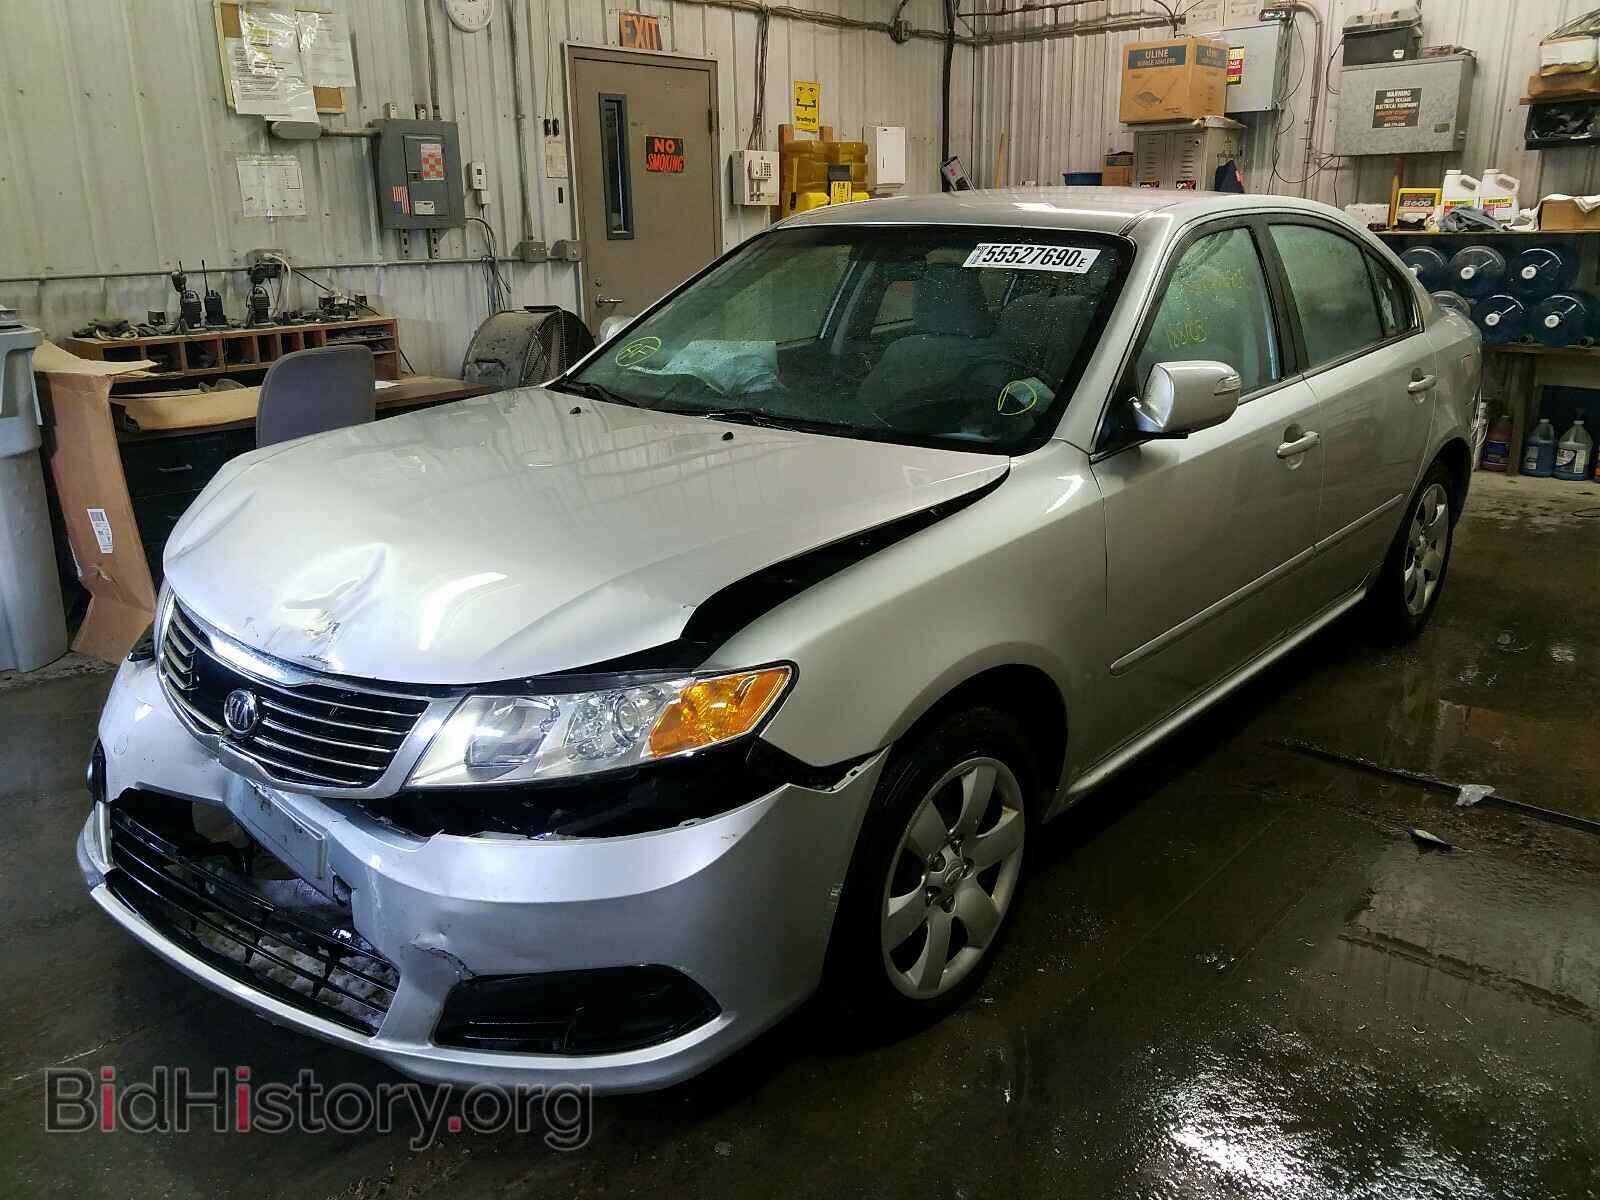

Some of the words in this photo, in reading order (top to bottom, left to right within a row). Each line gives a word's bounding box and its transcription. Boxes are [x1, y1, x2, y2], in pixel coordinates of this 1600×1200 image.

[621, 15, 659, 50] EXIT
[1145, 49, 1169, 59] ULINE
[654, 138, 675, 153] NO
[647, 153, 684, 171] SMOKING
